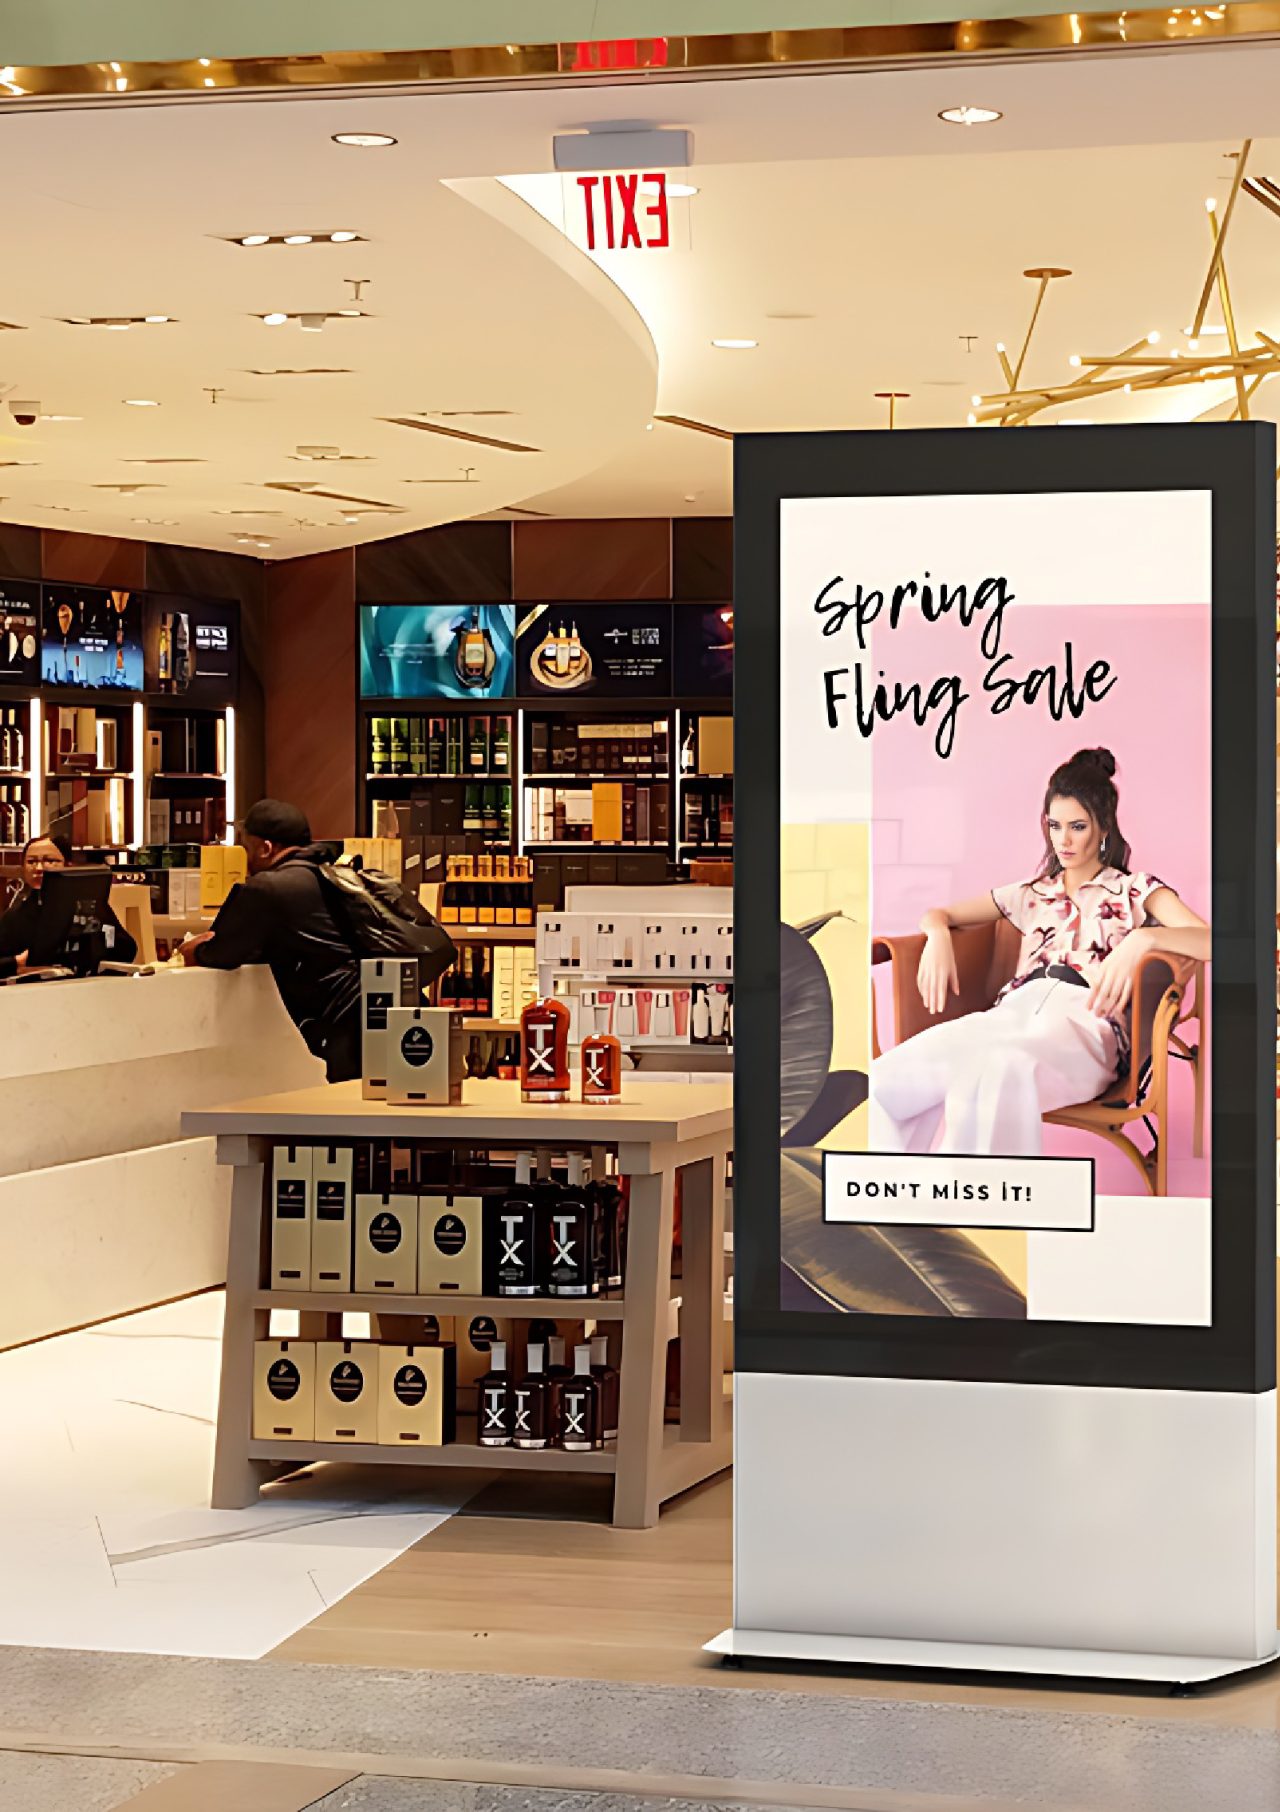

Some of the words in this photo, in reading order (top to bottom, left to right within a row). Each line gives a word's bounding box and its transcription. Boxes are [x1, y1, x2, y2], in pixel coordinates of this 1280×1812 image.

[814, 571, 1016, 660] Spring
[824, 662, 970, 759] Fling
[982, 641, 1118, 721] Sale
[846, 1181, 921, 1199] DON'T
